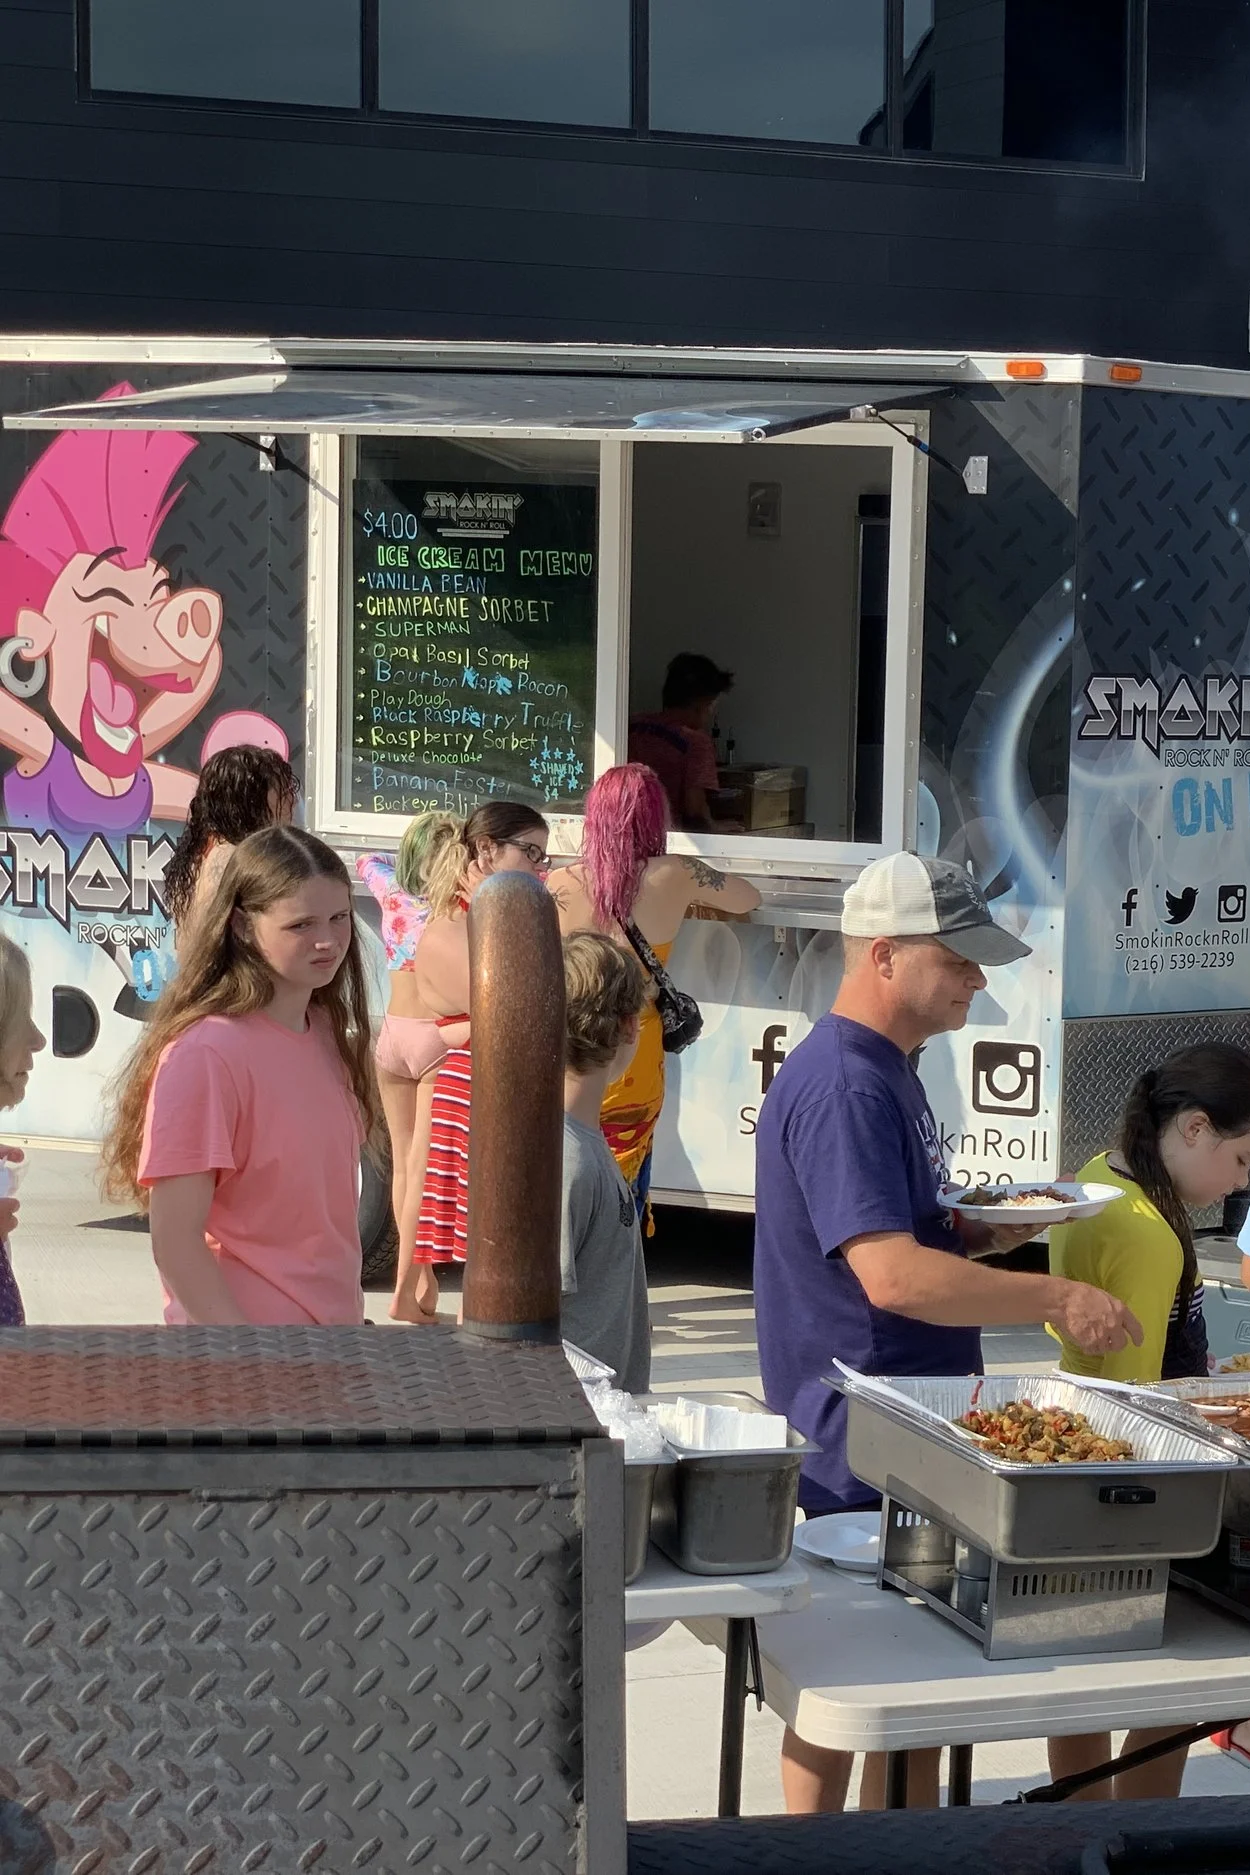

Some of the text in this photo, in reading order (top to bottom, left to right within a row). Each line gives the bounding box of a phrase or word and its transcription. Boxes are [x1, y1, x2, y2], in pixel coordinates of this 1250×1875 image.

[363, 508, 418, 539] $4.00
[460, 521, 479, 529] ROCK
[489, 522, 506, 530] ROLL
[377, 545, 593, 576] ICE CREAM MENU
[367, 572, 487, 594] VANILLA BEAN
[366, 595, 554, 623] CHAMPAGNE SORBET
[375, 621, 471, 637] SUPERMAN
[427, 643, 469, 668] Basil
[478, 646, 530, 670] Sorbet
[376, 659, 458, 687] Bourbon
[371, 689, 452, 709] Play Dough
[373, 706, 417, 724] Black
[521, 702, 584, 733] Truffle
[371, 726, 538, 752] Raspberry Sorbet
[372, 751, 483, 764] Deluxe Chocolate
[1164, 748, 1211, 767] ROCK
[1212, 747, 1231, 768] N'
[373, 766, 448, 791] Banana
[374, 795, 439, 813] Buckeye
[544, 785, 559, 802] $4
[1172, 778, 1235, 837] ON
[78, 922, 139, 947] ROCK
[145, 926, 167, 948] N'
[1115, 929, 1250, 950] SmokinRocknRoll
[1125, 952, 1235, 975] (216) 539-2239
